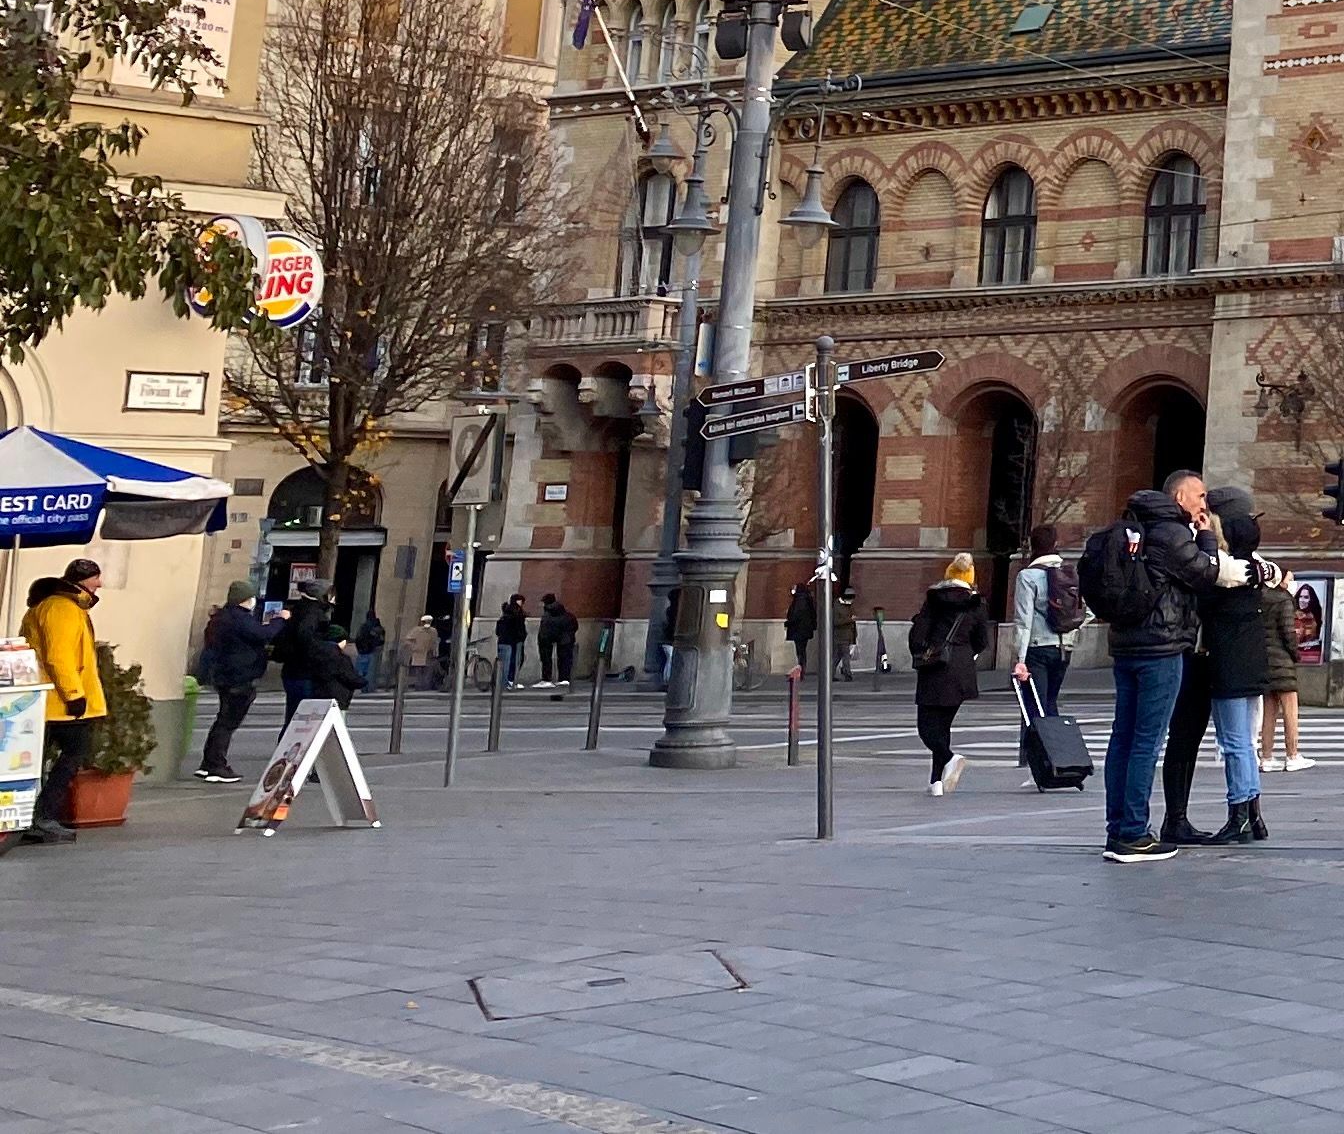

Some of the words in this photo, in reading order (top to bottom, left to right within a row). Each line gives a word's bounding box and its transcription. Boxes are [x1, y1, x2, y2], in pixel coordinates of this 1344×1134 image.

[268, 256, 313, 275] RGER
[862, 363, 889, 374] Liberty
[891, 358, 918, 369] Bridge
[43, 492, 93, 511] CARD
[12, 514, 45, 525] official
[47, 514, 66, 525] city
[67, 513, 89, 523] pass
